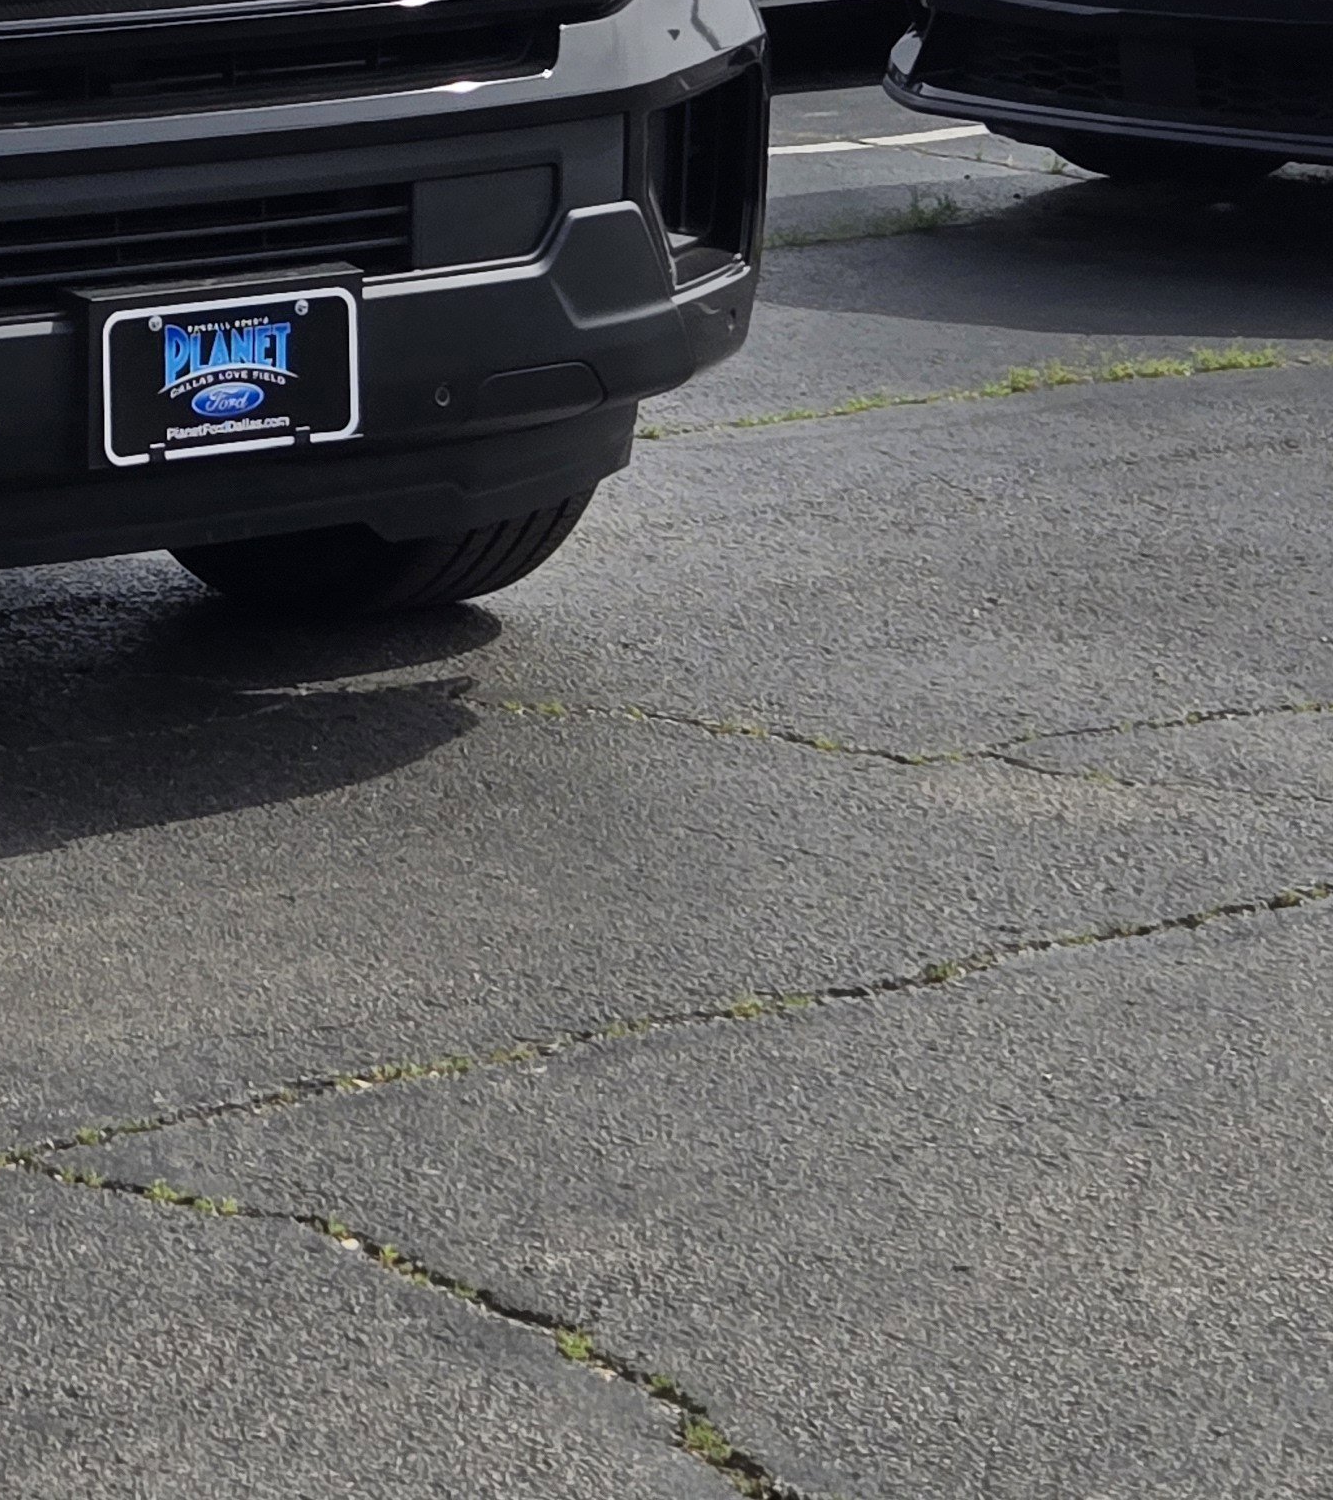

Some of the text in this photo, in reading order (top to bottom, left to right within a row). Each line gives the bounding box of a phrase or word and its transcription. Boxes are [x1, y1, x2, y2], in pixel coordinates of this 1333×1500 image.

[164, 322, 291, 388] PLANET
[218, 370, 249, 381] LOVE
[252, 370, 287, 386] FIELD
[205, 389, 250, 412] Ford
